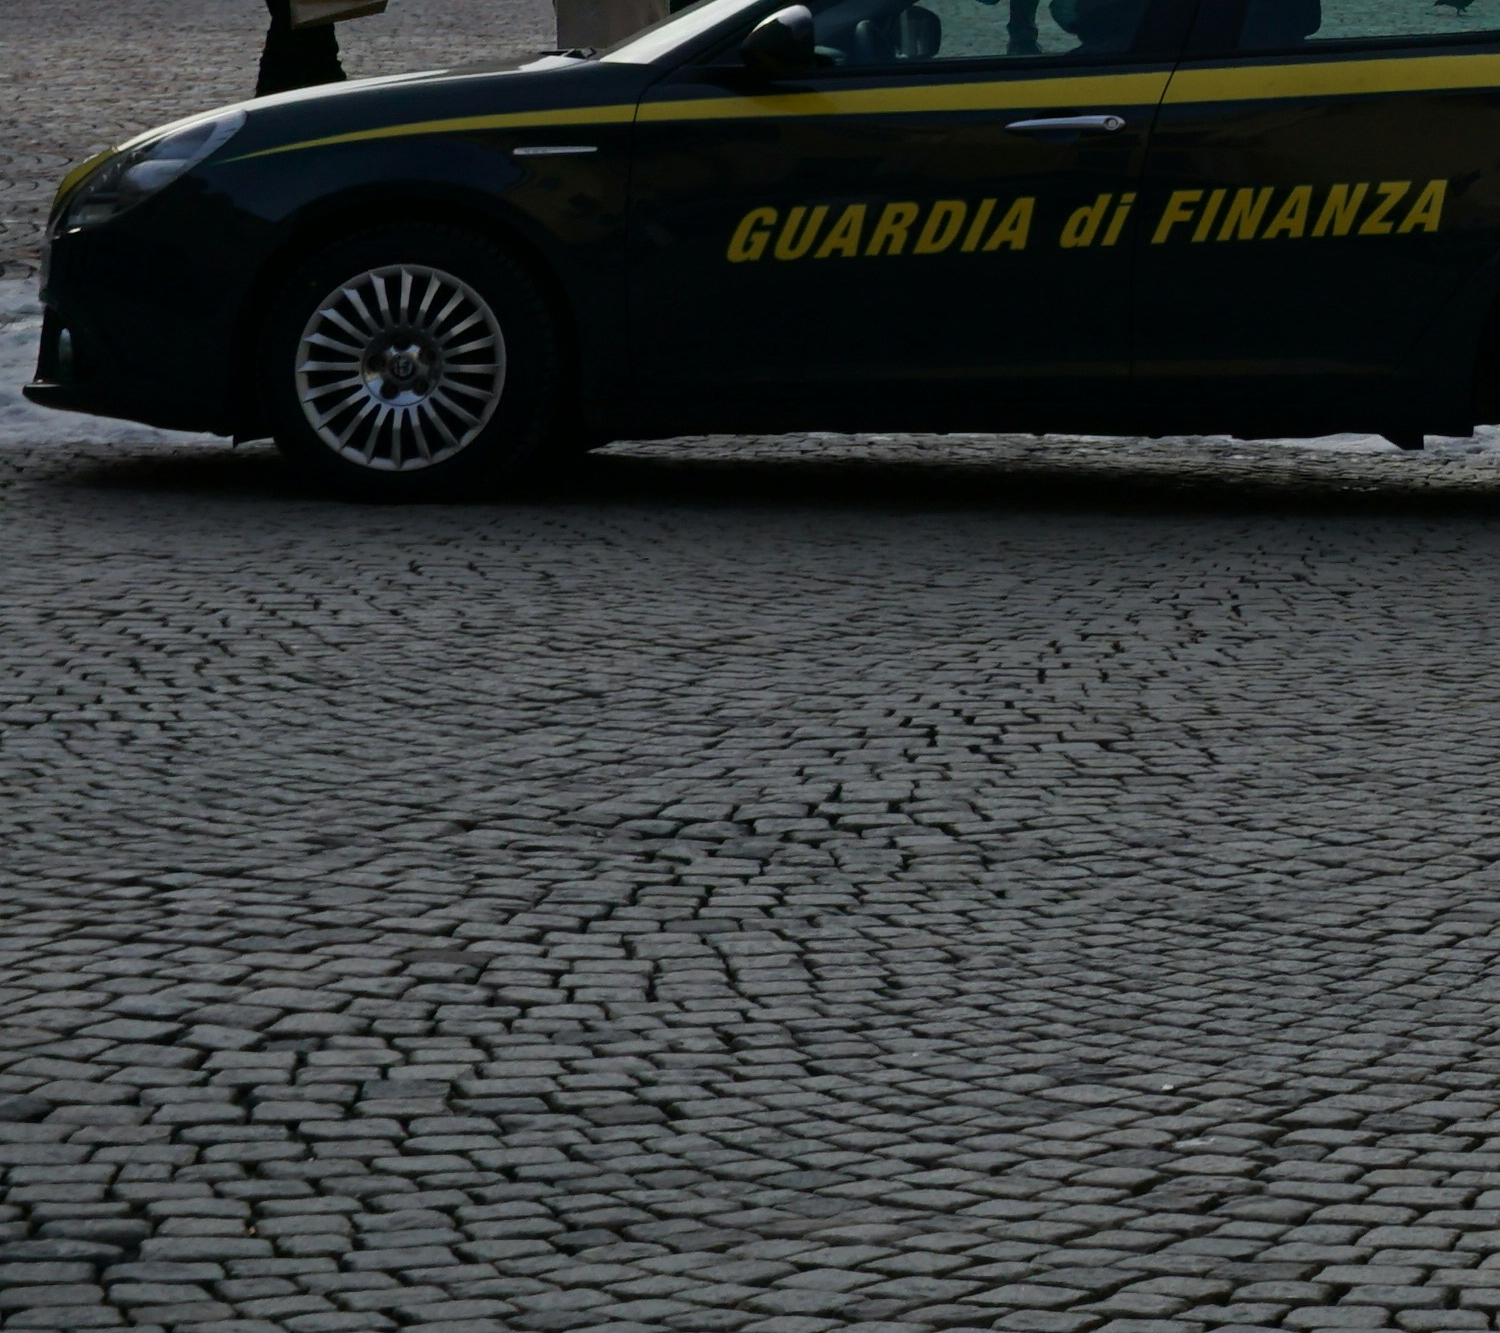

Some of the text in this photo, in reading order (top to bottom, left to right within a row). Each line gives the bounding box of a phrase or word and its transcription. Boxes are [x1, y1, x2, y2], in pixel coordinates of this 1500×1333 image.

[726, 179, 1449, 263] GUARDIA di FINANZA
